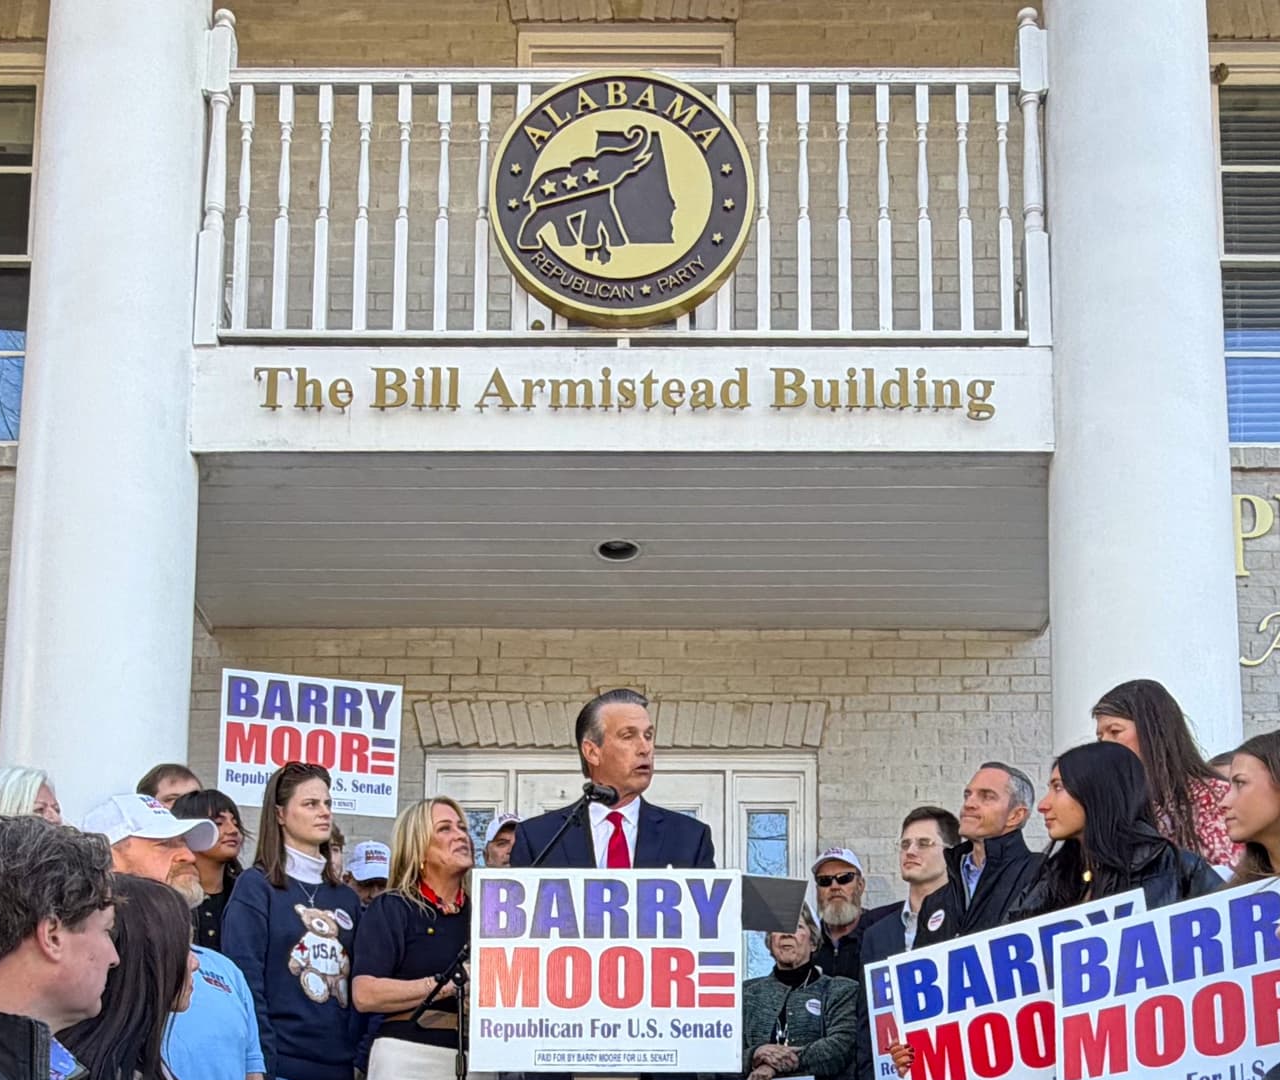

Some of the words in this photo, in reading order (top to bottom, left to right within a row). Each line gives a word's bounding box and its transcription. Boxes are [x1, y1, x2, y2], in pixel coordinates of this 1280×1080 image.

[523, 81, 721, 150] ALABAMA
[531, 250, 634, 299] REPUBLICAN
[657, 255, 705, 292] PARTY
[254, 366, 354, 411] The
[370, 365, 460, 411] Bill
[478, 366, 749, 411] Armistead
[771, 366, 996, 421] Building
[227, 675, 396, 731] BARRY
[225, 721, 396, 776] MOORE
[351, 779, 392, 795] Senate
[479, 878, 732, 939] BARRY
[313, 944, 338, 961] USA
[478, 946, 735, 1009] MOORE
[480, 1018, 583, 1042] Republican
[590, 1018, 621, 1038] For
[627, 1018, 663, 1038] U.S.
[670, 1018, 733, 1039] Senate
